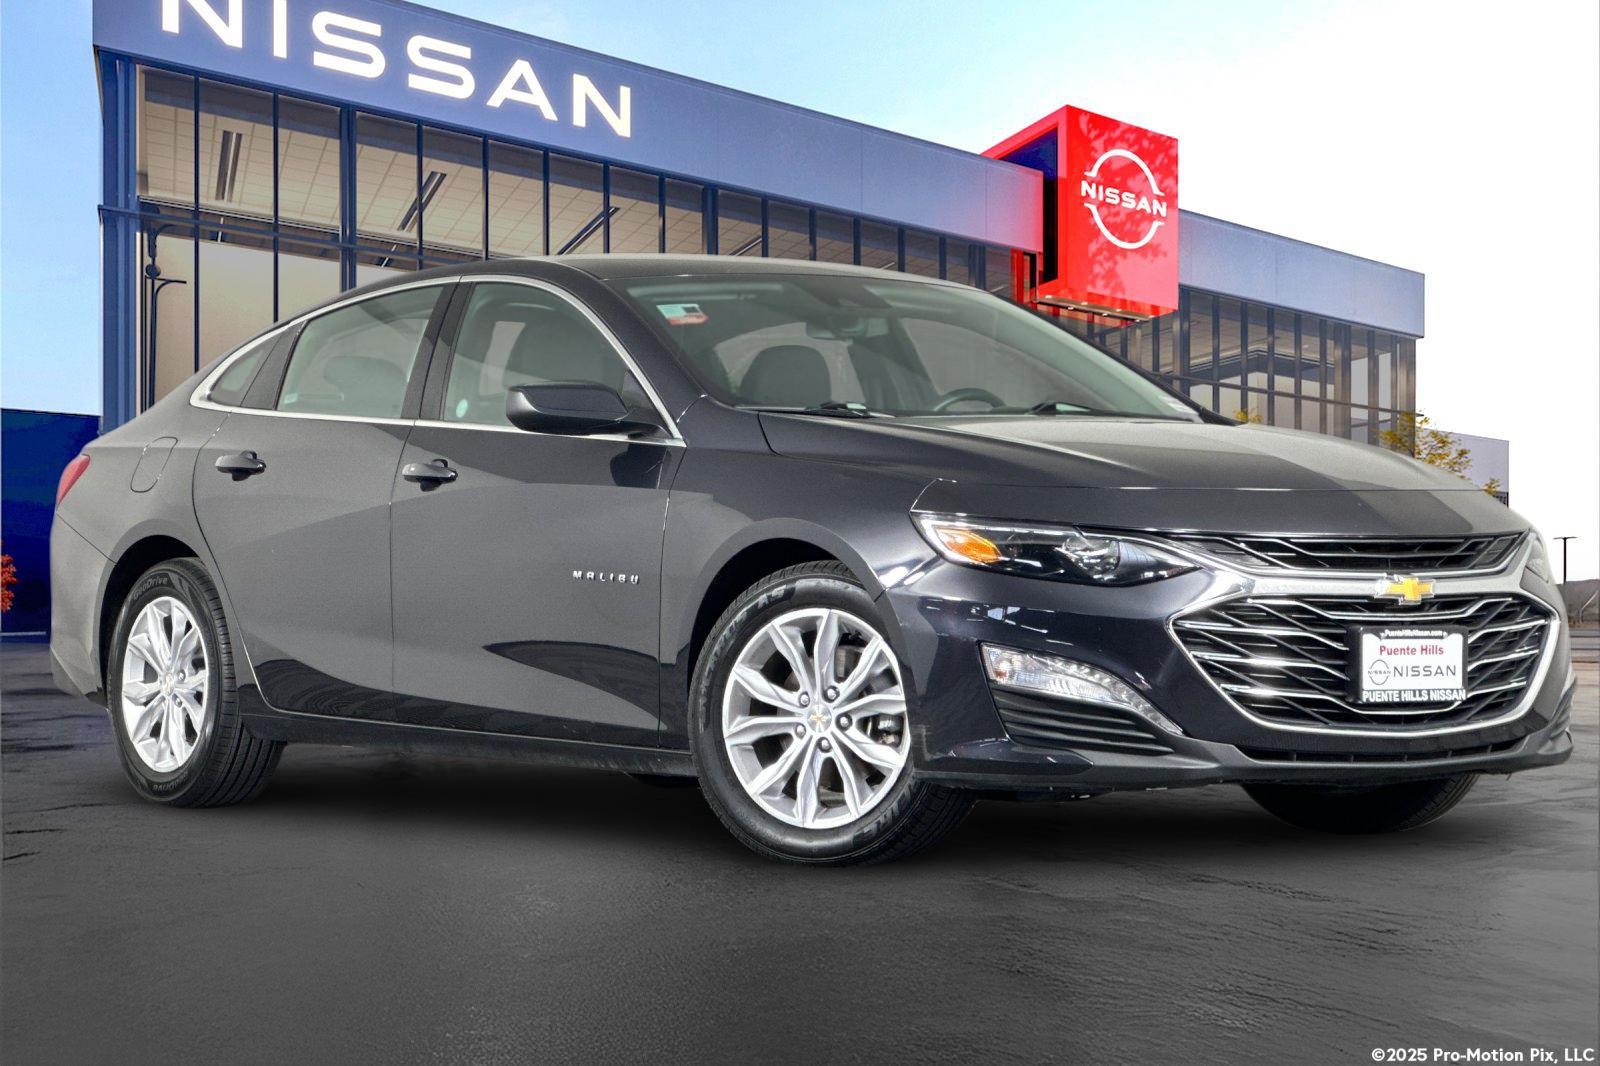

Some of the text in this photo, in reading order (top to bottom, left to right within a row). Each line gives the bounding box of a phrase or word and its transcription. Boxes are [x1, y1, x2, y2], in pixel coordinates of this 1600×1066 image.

[1081, 180, 1167, 217] NISSAN
[572, 570, 639, 585] MALIBU
[1379, 645, 1444, 656] Puente Hills
[1393, 665, 1456, 678] NISSAN
[1362, 689, 1467, 703] PUENTE HILLS NISSAN
